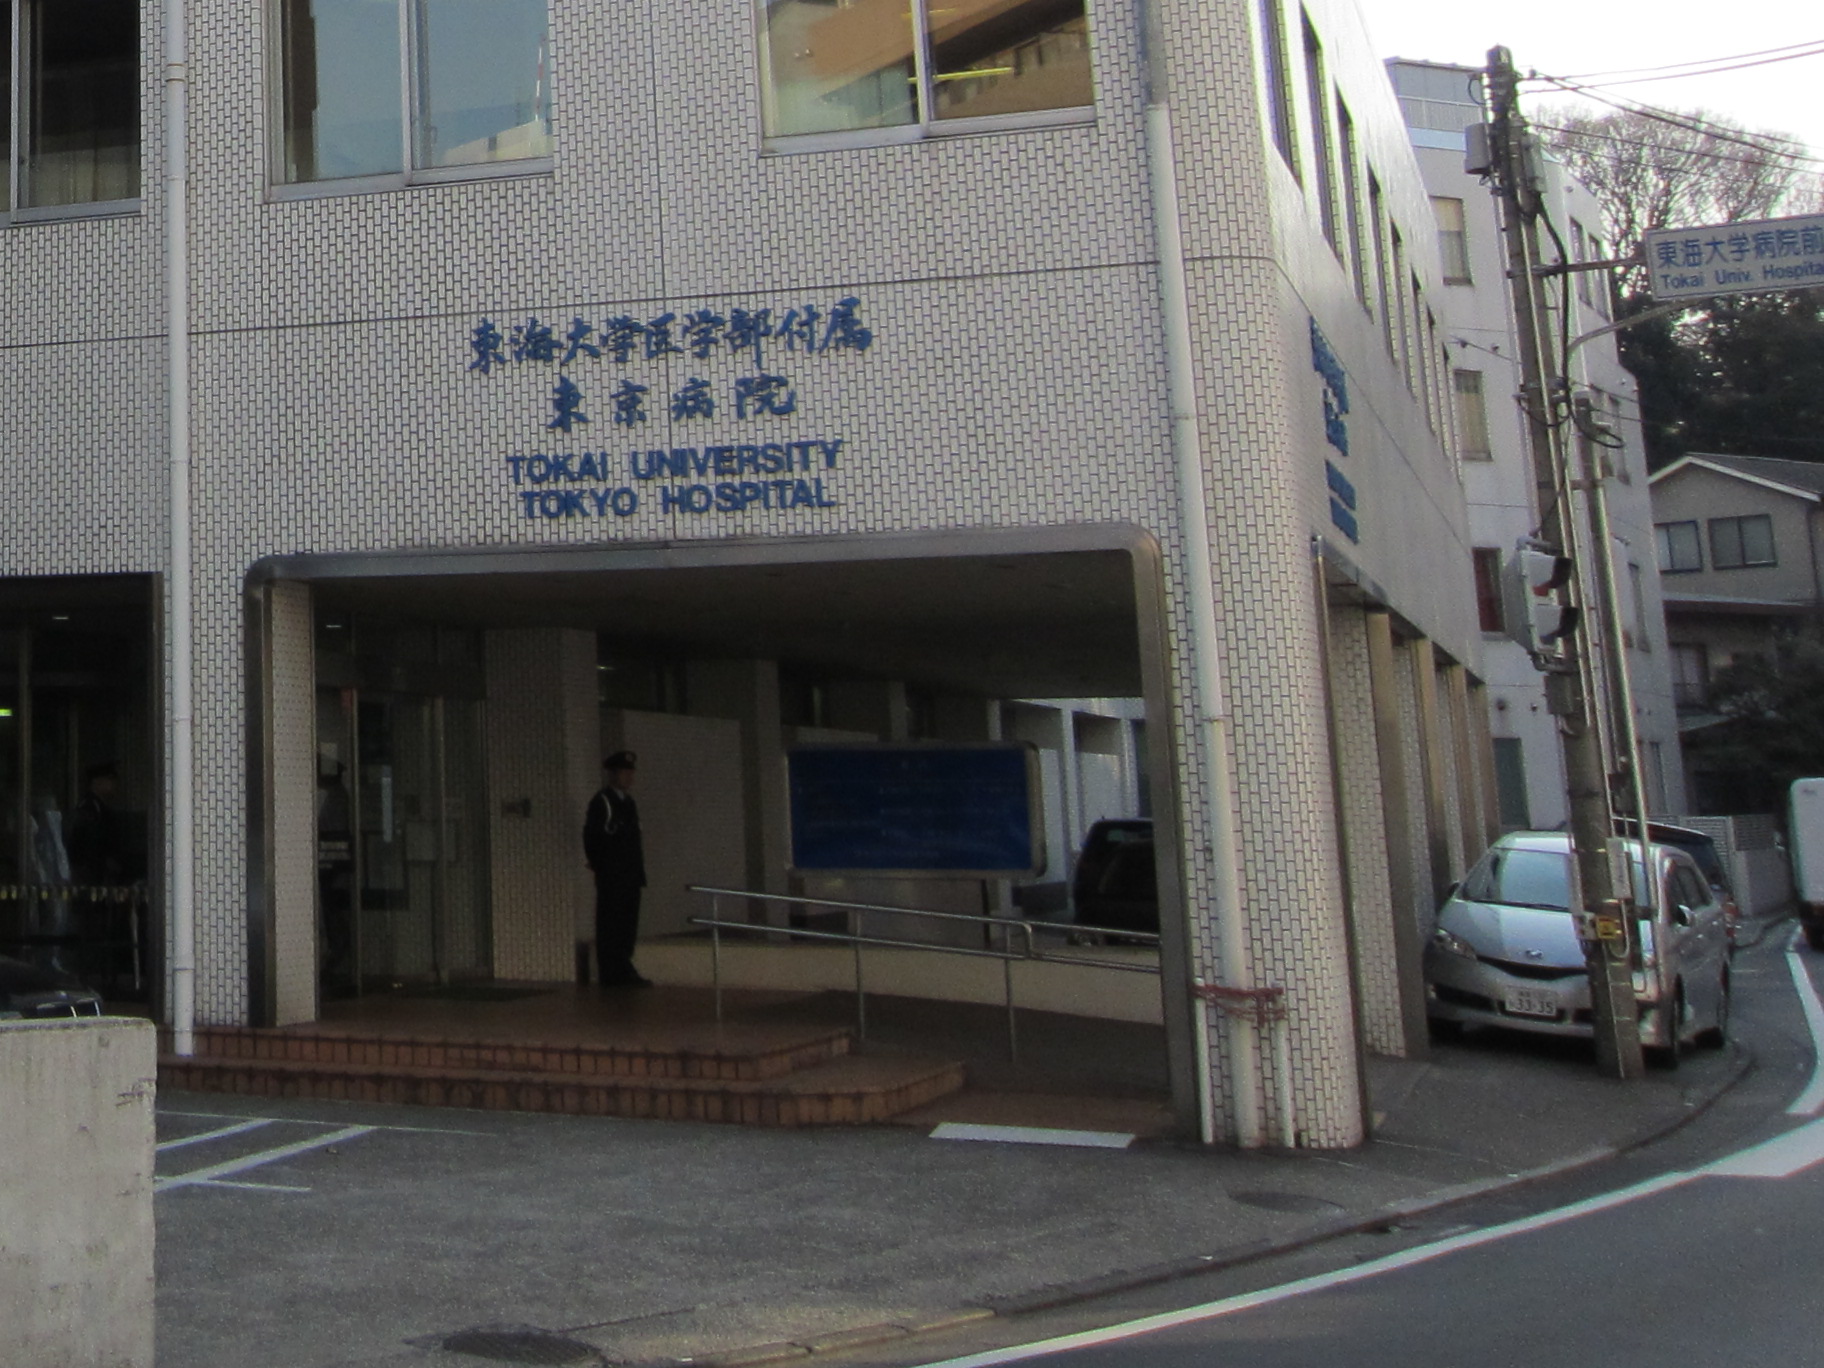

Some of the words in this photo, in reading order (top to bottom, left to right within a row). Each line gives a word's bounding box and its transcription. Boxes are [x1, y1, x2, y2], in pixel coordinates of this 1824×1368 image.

[1660, 272, 1704, 289] Tokai
[1715, 268, 1751, 285] Univ.
[1762, 262, 1824, 280] Hospita
[469, 297, 873, 374] 東海大学医学部付属
[548, 374, 796, 432] 東京病院
[507, 452, 609, 484] TOKAI
[632, 439, 844, 479] UNIVERSITY
[520, 487, 638, 520] TOKYO
[663, 478, 836, 515] HOSPITAL
